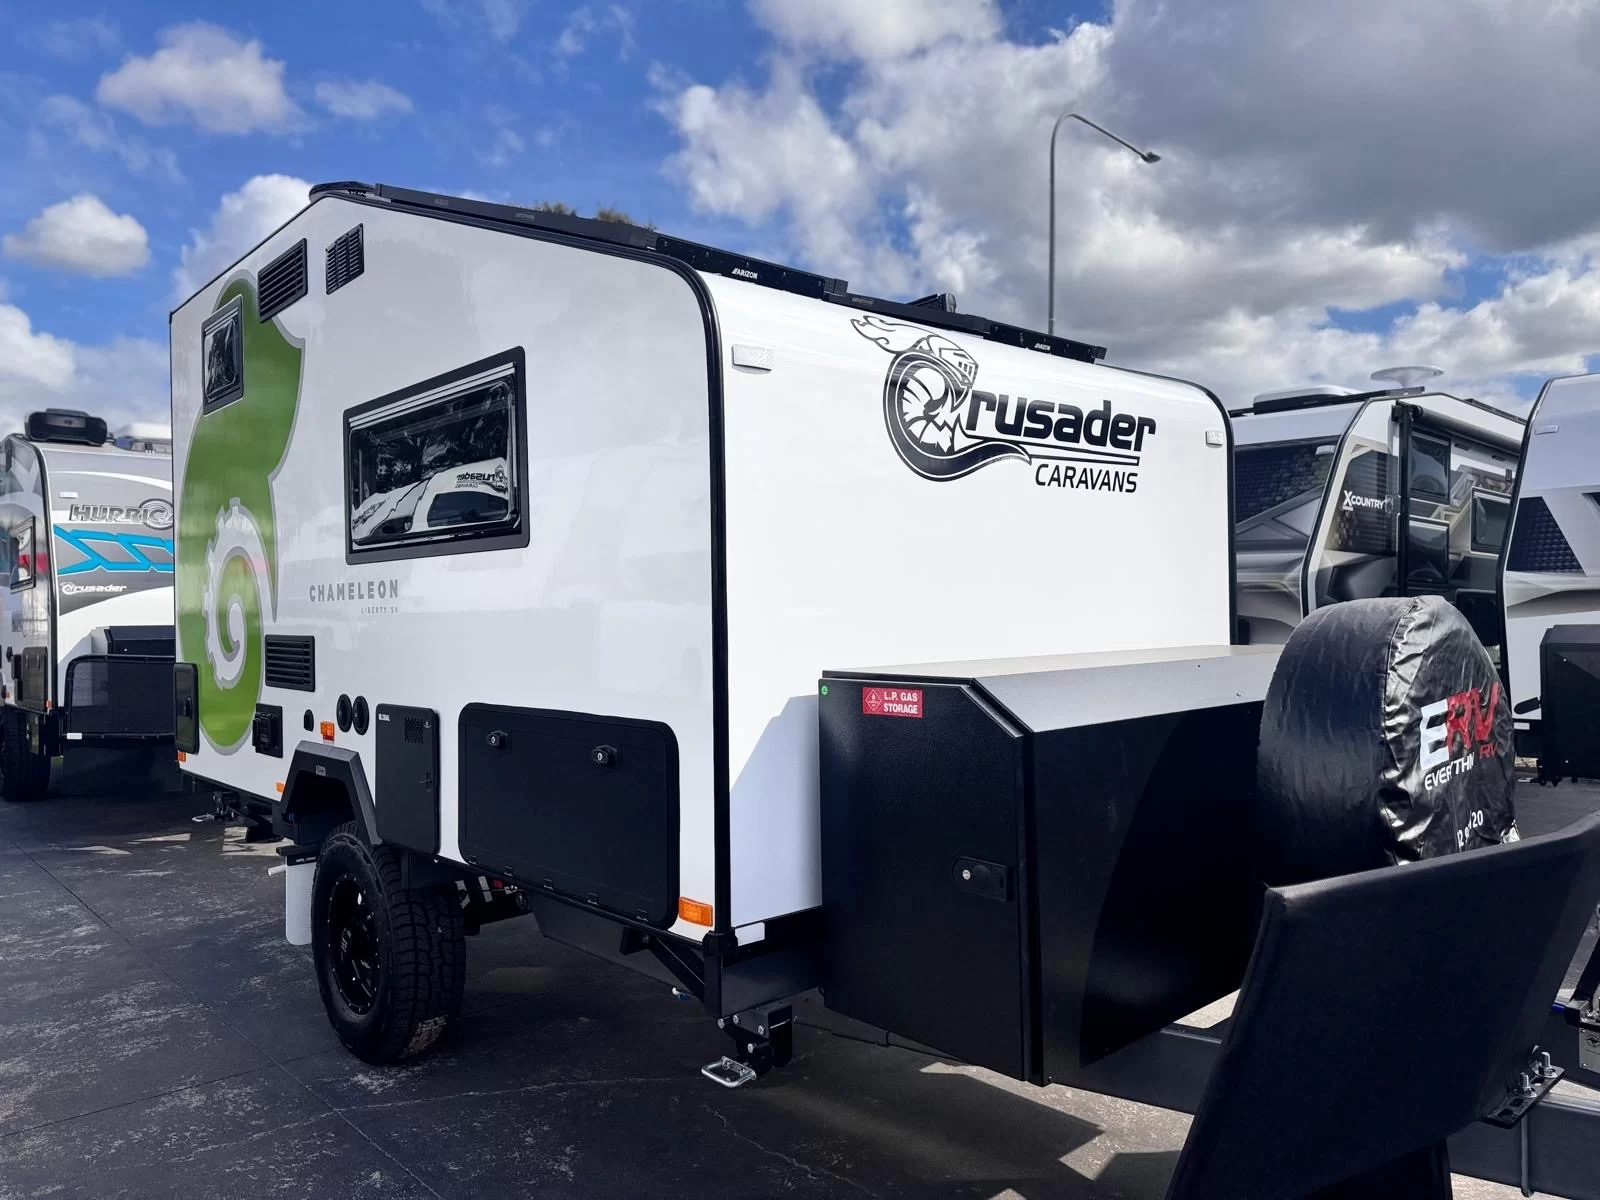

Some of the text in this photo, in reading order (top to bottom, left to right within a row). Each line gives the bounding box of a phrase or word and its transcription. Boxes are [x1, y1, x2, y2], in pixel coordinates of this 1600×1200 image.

[1035, 463, 1138, 493] CARAVANS
[309, 579, 398, 602] CHAMELEON
[883, 691, 918, 702] L.P. GAS
[883, 702, 919, 714] STORAGE
